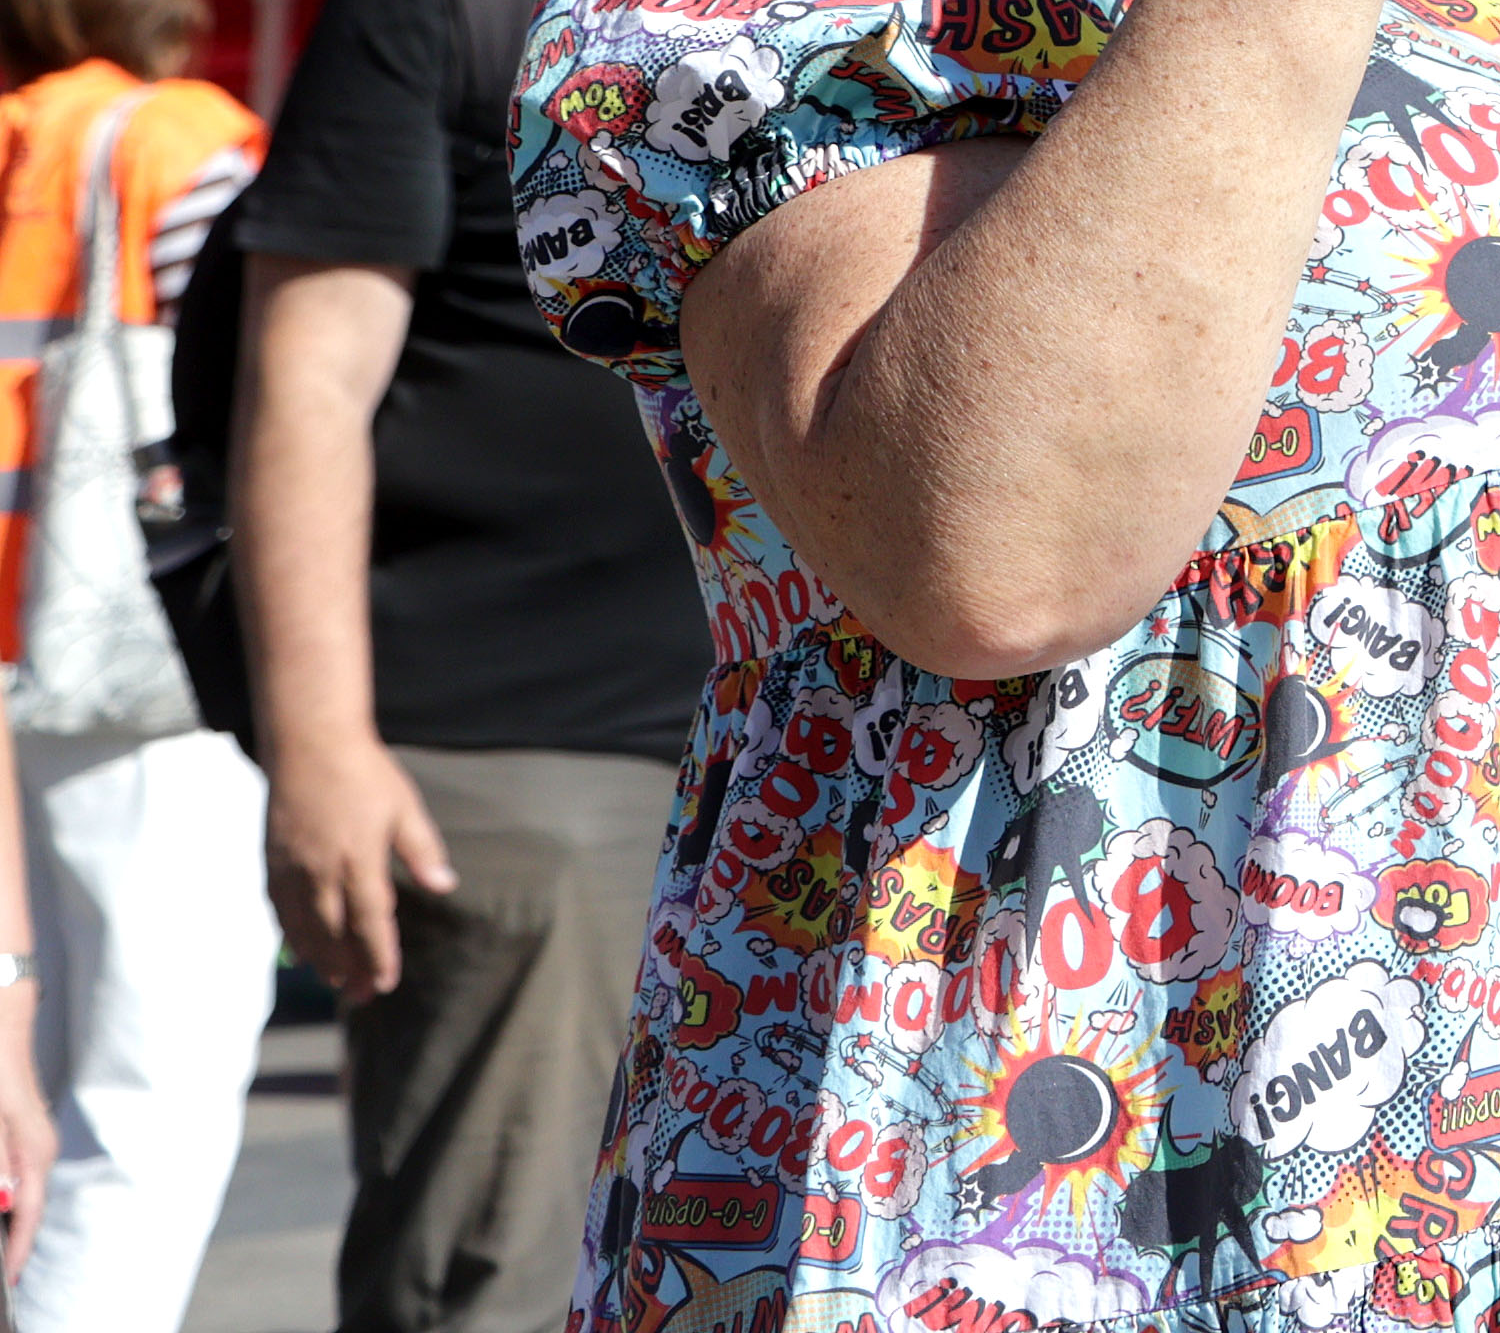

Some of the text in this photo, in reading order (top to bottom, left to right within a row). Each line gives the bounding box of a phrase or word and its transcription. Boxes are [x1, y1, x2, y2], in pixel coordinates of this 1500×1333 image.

[1322, 596, 1422, 673] BANG!
[1120, 679, 1244, 761] WTF!?
[1250, 1007, 1388, 1141] BANG!
